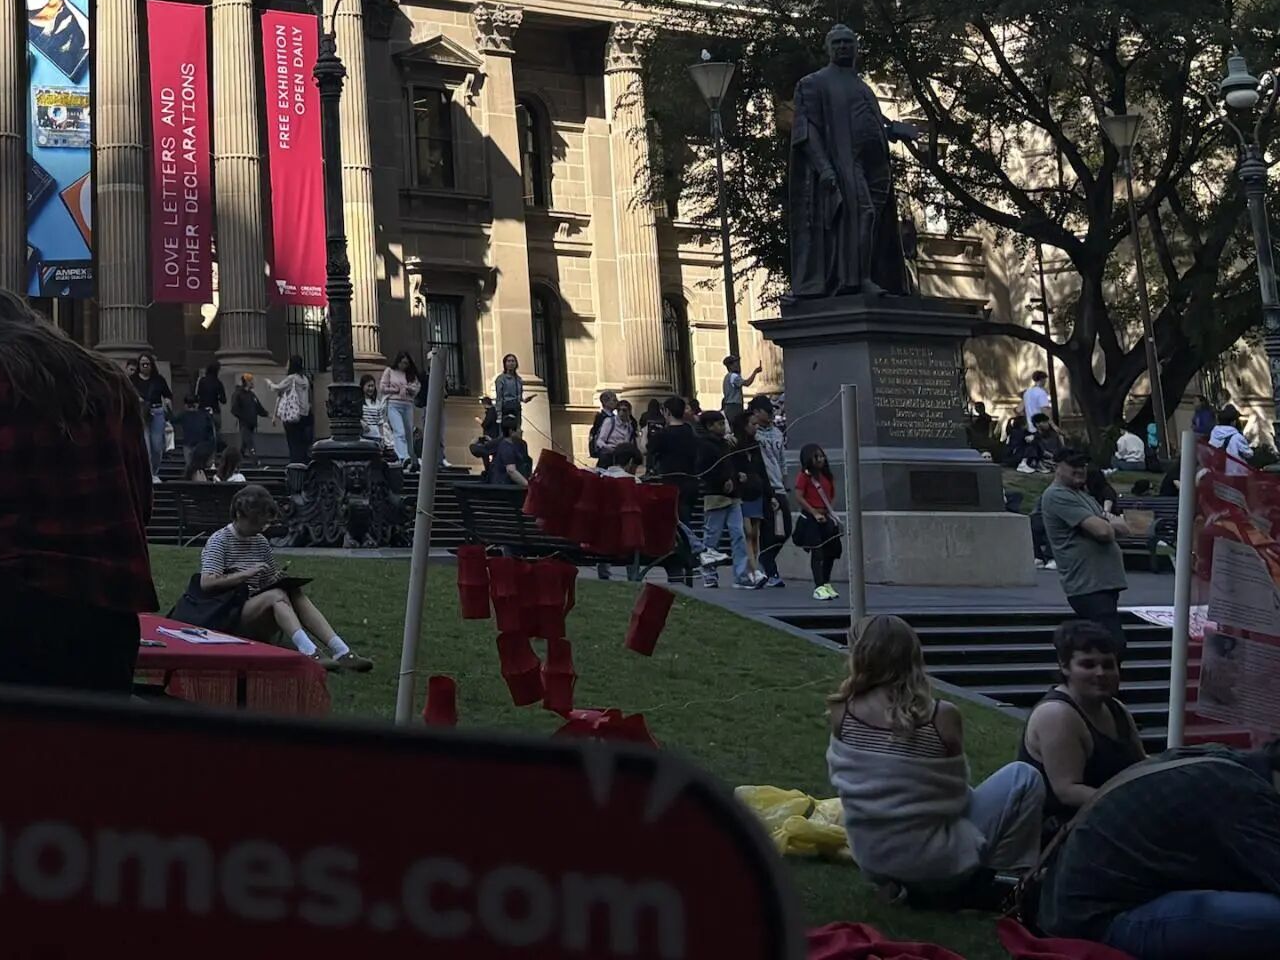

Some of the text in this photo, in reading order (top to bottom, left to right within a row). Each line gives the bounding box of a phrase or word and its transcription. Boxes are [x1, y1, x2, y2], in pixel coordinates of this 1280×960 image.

[275, 24, 290, 149] FREE EXHIBITION
[291, 26, 306, 115] OPEN DAILY
[160, 87, 180, 288] LOVE LETTERS AND
[181, 62, 201, 290] OTHER DECLARATIONS
